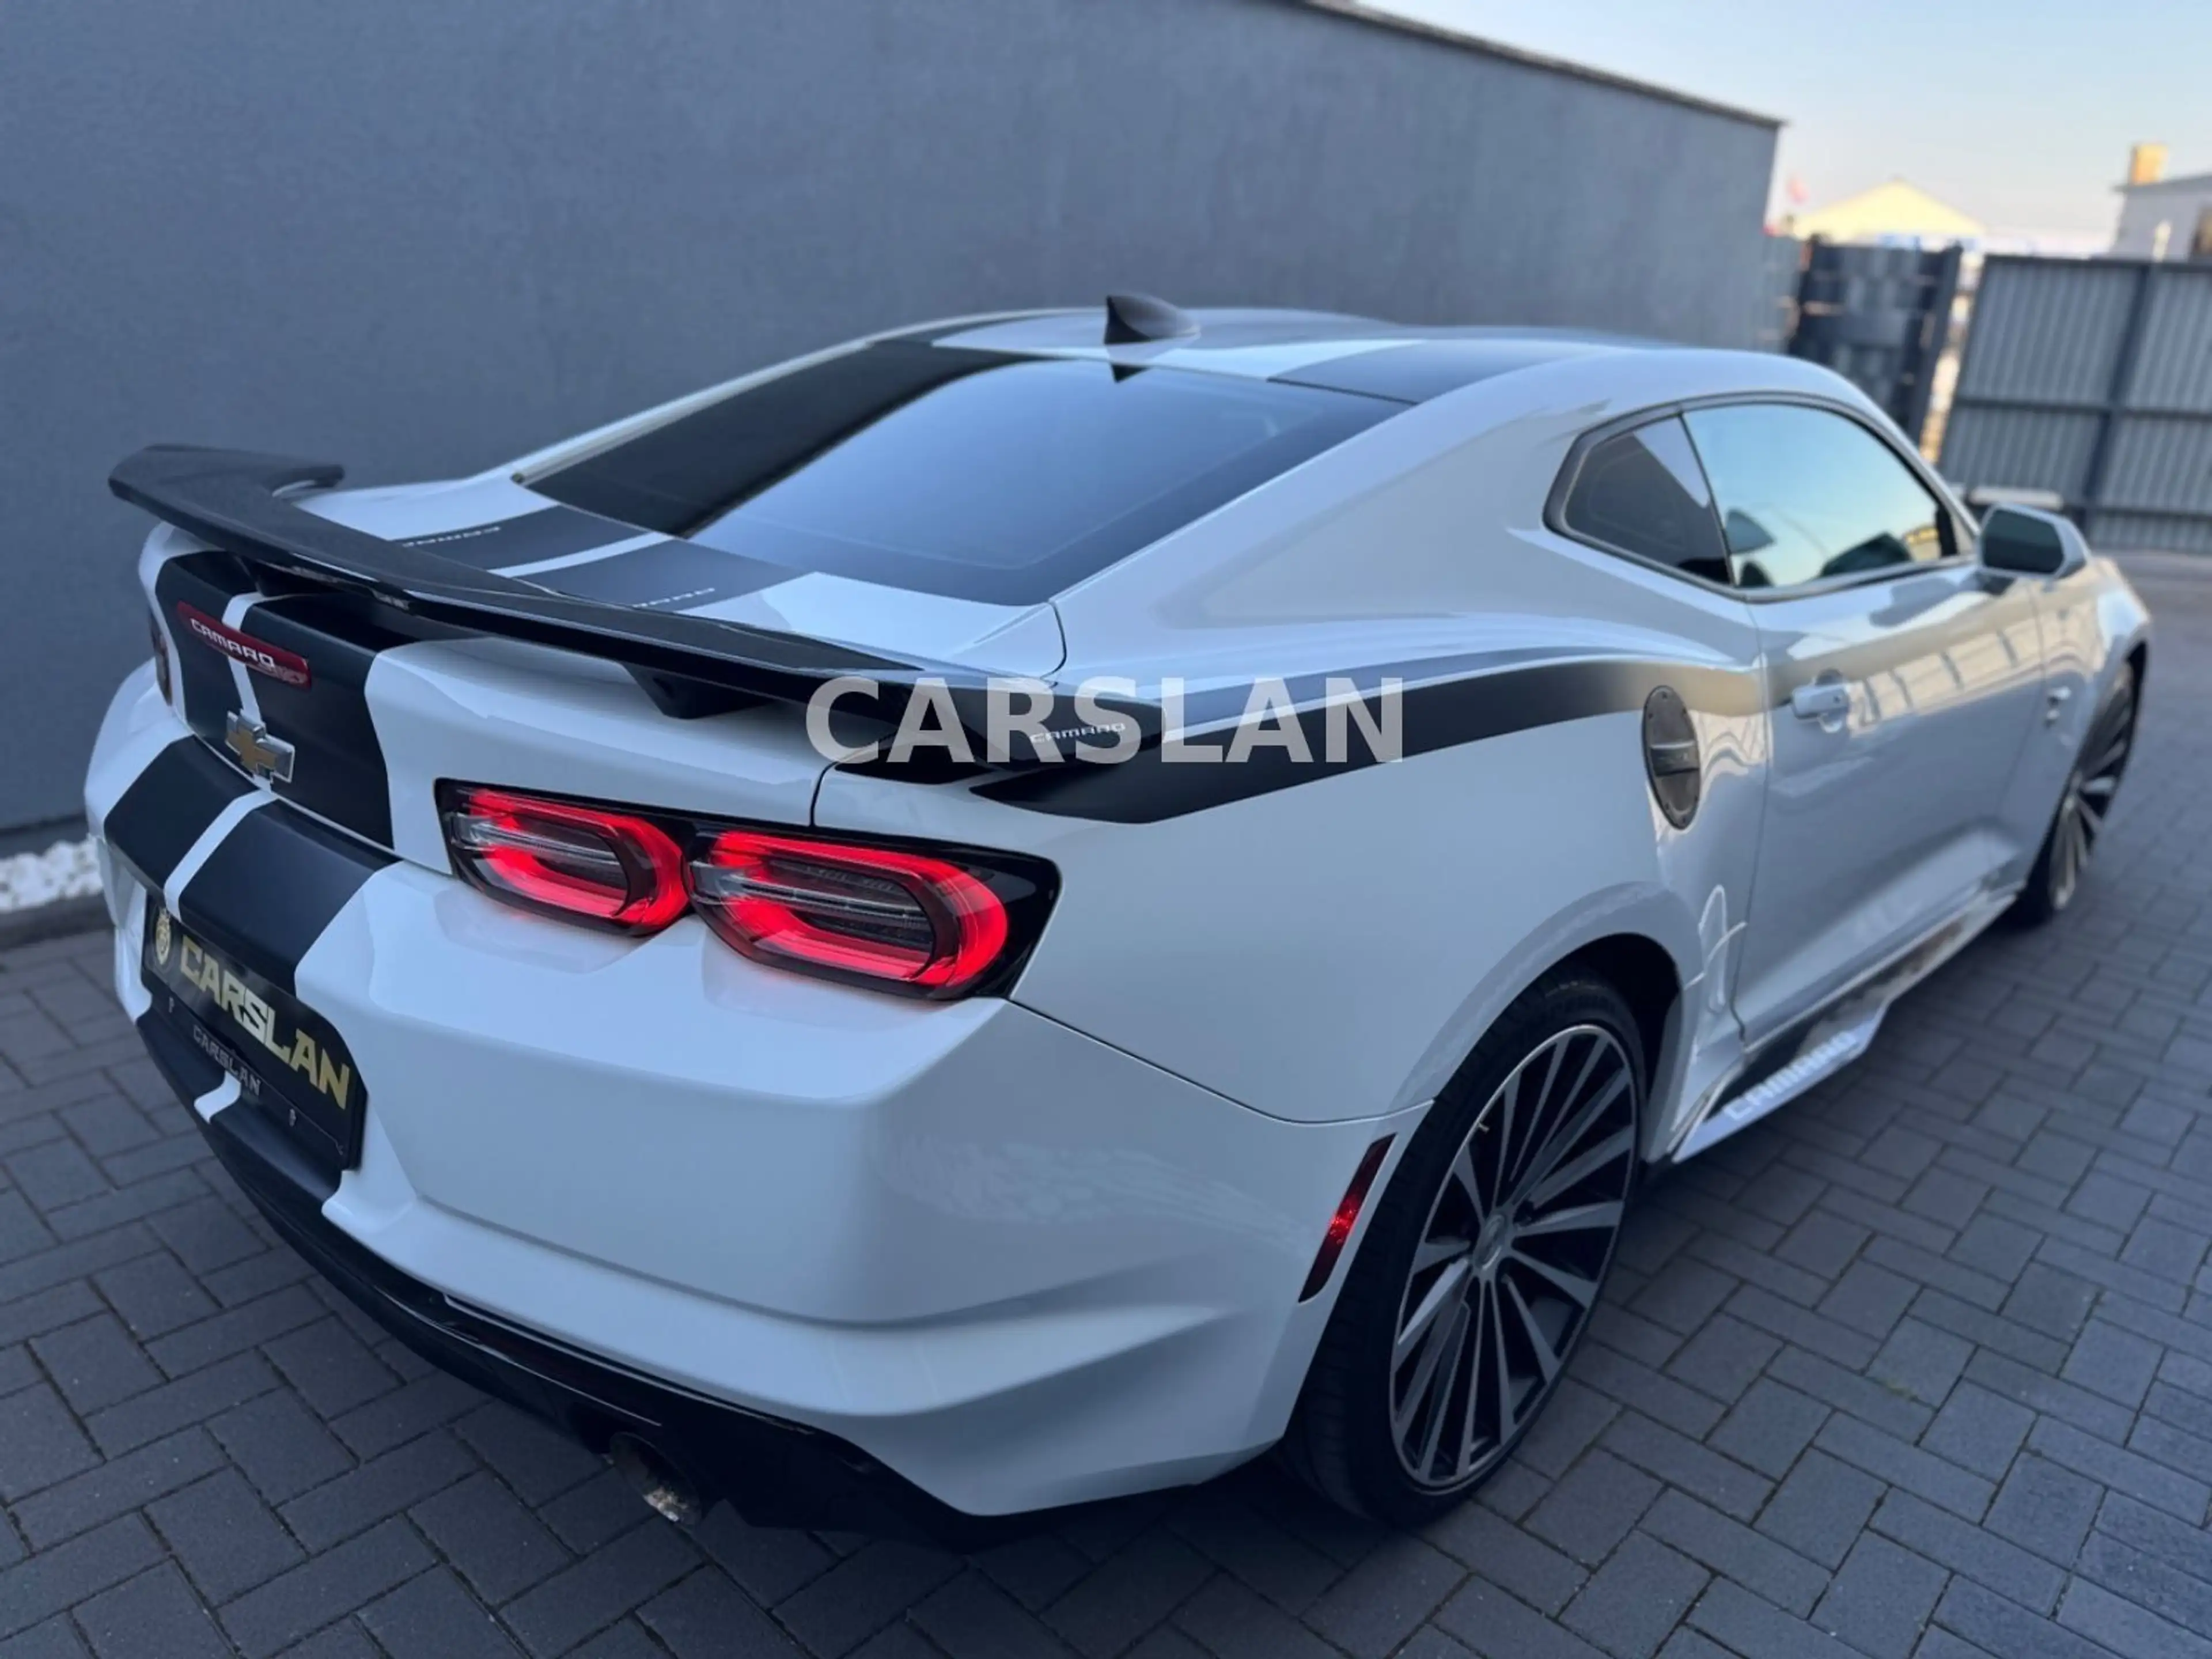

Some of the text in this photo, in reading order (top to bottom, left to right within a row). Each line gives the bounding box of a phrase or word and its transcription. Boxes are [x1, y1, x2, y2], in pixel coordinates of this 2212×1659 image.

[190, 618, 275, 669] CAMARO
[179, 934, 350, 1109] CARSLAN
[193, 1024, 262, 1096] CARSLAN
